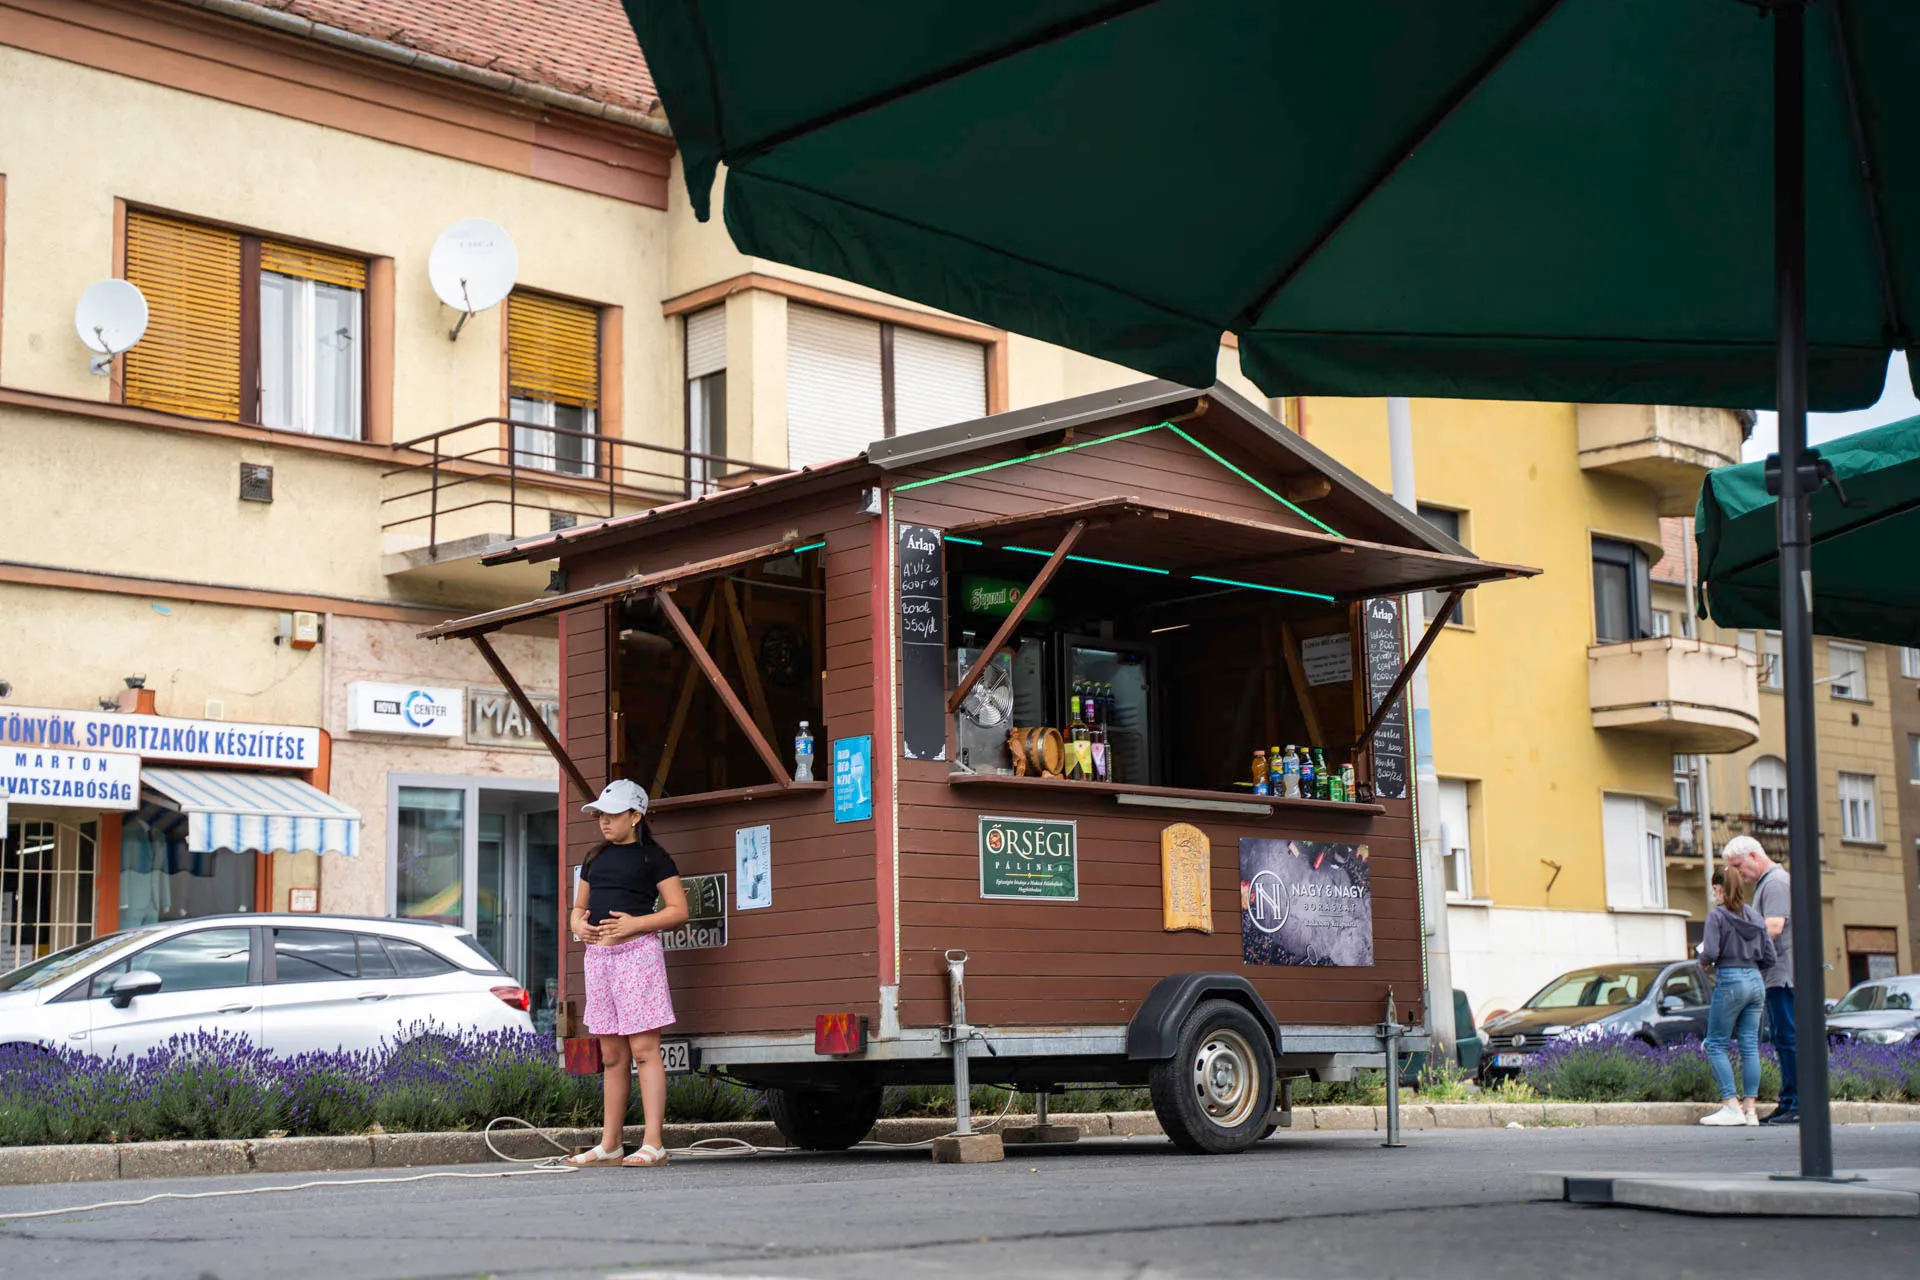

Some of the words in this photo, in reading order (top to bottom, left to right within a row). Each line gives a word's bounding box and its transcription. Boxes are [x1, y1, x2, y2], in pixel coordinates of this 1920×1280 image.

[906, 534, 936, 556] Árlap
[1372, 605, 1394, 624] Árlap
[414, 703, 447, 717] CENTER
[86, 721, 209, 754] SPORTZAKÓK
[214, 727, 305, 761] KÉSZÍTÉSE
[15, 752, 108, 772] MARTON
[985, 823, 1071, 860] ŐRSÉGI
[995, 861, 1063, 873] PÁLINKA
[1291, 883, 1324, 897] NAGY
[1325, 884, 1333, 897] &
[1334, 885, 1365, 899] NAGY
[658, 924, 722, 949] ineken
